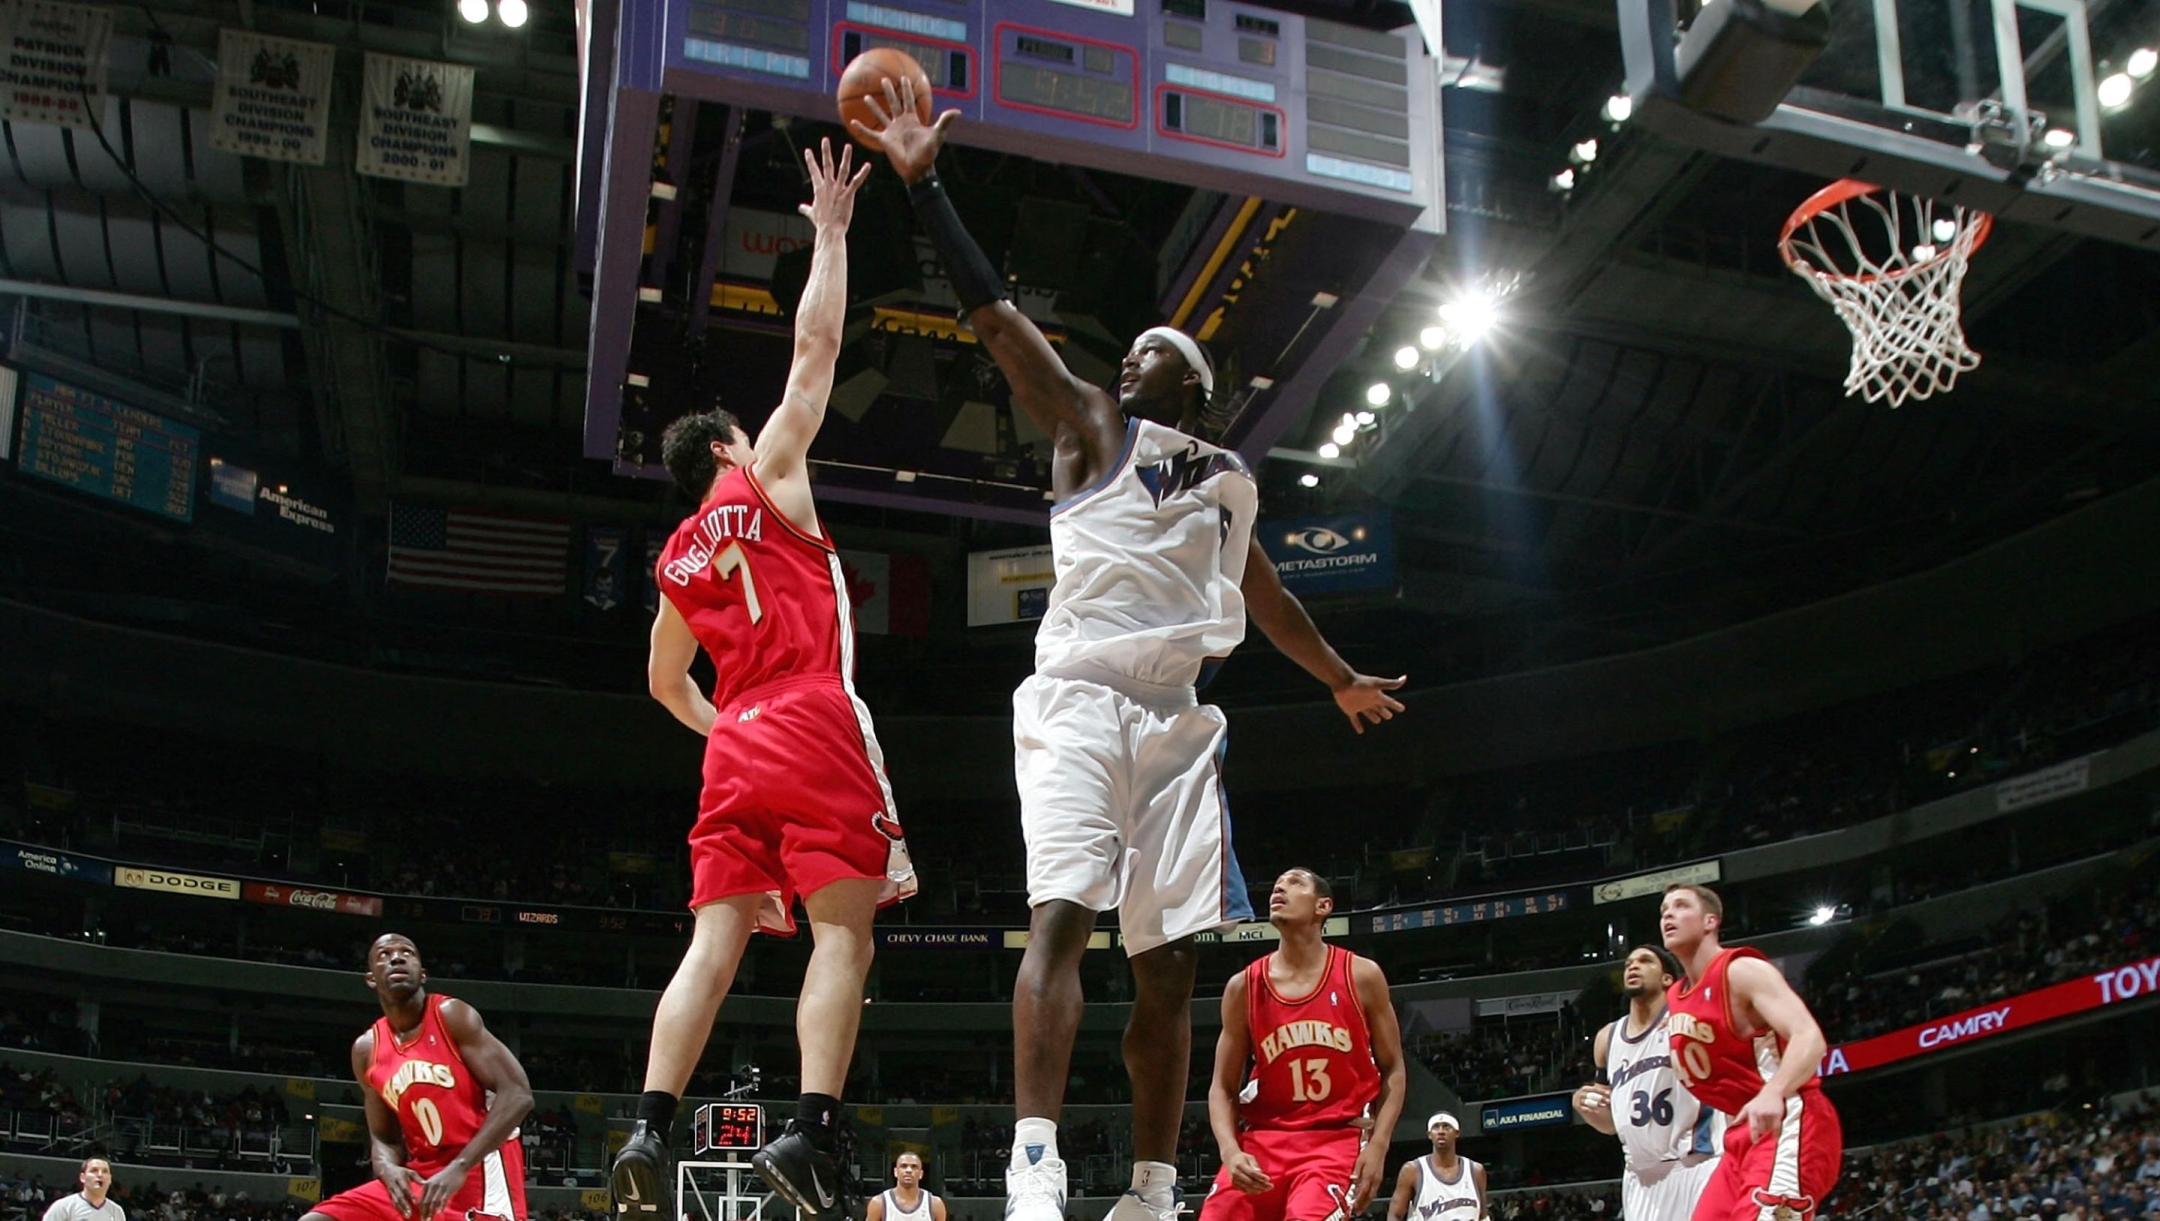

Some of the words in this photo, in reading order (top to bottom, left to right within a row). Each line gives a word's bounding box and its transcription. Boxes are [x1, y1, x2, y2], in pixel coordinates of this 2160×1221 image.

[14, 36, 85, 58] PATRICK
[11, 54, 87, 77] DIVISION
[227, 85, 316, 109] SOUTHEAST
[238, 101, 304, 122] DIVISION
[373, 105, 458, 130] SOUTHEAST
[225, 112, 315, 137] CHAMPIONS
[383, 122, 448, 143] DIVISION
[371, 134, 457, 158] CHAMPIONS
[259, 486, 328, 519] American
[279, 503, 335, 534] Express
[664, 504, 762, 587] GUGLIOTTA
[712, 539, 763, 625] 7
[18, 850, 57, 865] America
[25, 859, 57, 873] Online
[150, 874, 231, 893] DODGE
[519, 911, 558, 924] WIZARDS
[887, 933, 922, 943] CHEVY
[925, 933, 957, 943] CHASE
[960, 933, 988, 943] BANK
[1239, 930, 1263, 941] MCI
[1918, 1007, 2010, 1048] CAMRY
[1261, 1020, 1353, 1065] HAWKS
[383, 1059, 455, 1112] HAWKS
[1288, 1058, 1331, 1102] 13
[722, 1108, 757, 1121] 9:52
[1500, 1115, 1517, 1125] AXA
[1519, 1110, 1565, 1122] FINANCIAL
[1631, 1087, 1674, 1127] 36
[719, 1125, 751, 1145] 24
[296, 1181, 317, 1193] 107
[588, 1192, 608, 1205] 106
[1418, 1197, 1478, 1220] WIZARDS
